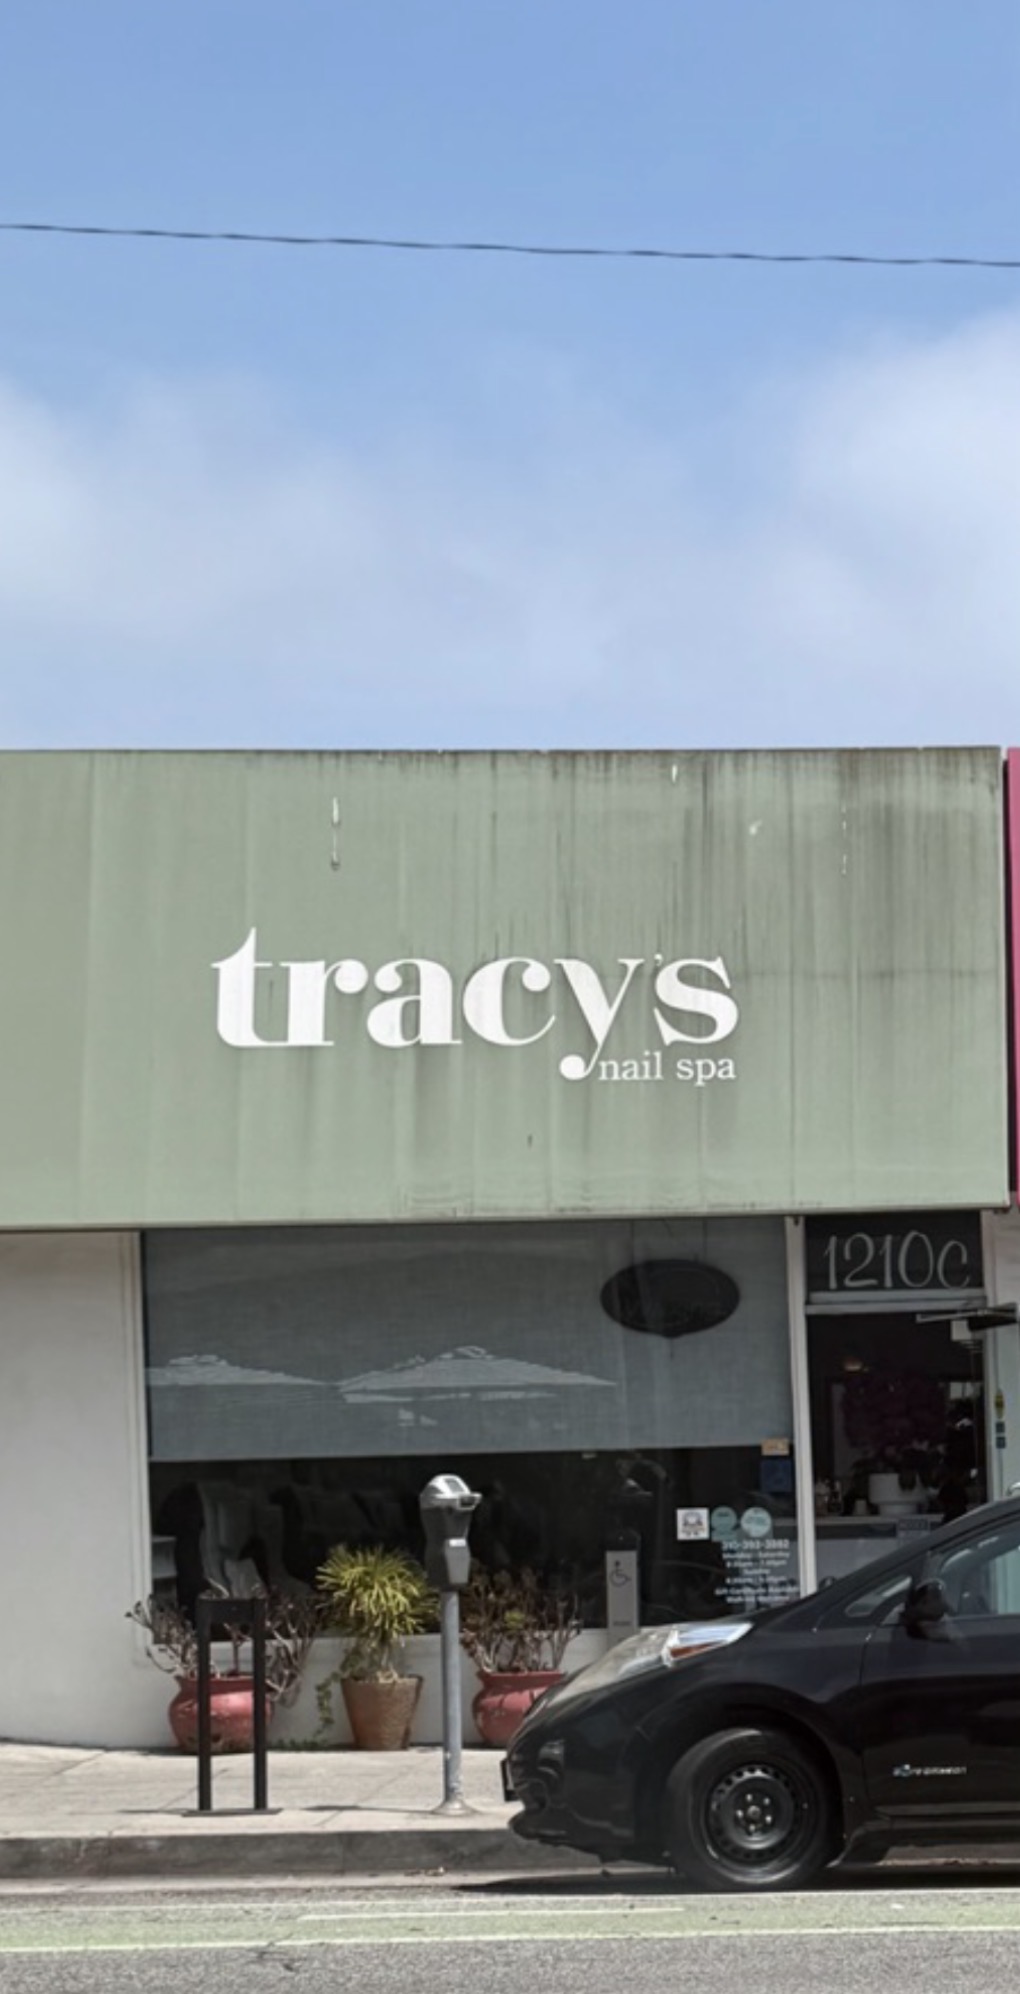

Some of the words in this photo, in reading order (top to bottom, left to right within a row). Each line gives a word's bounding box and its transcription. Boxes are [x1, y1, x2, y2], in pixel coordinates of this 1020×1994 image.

[210, 926, 739, 1081] tracy's
[597, 1050, 663, 1081] nail
[676, 1058, 737, 1087] spa
